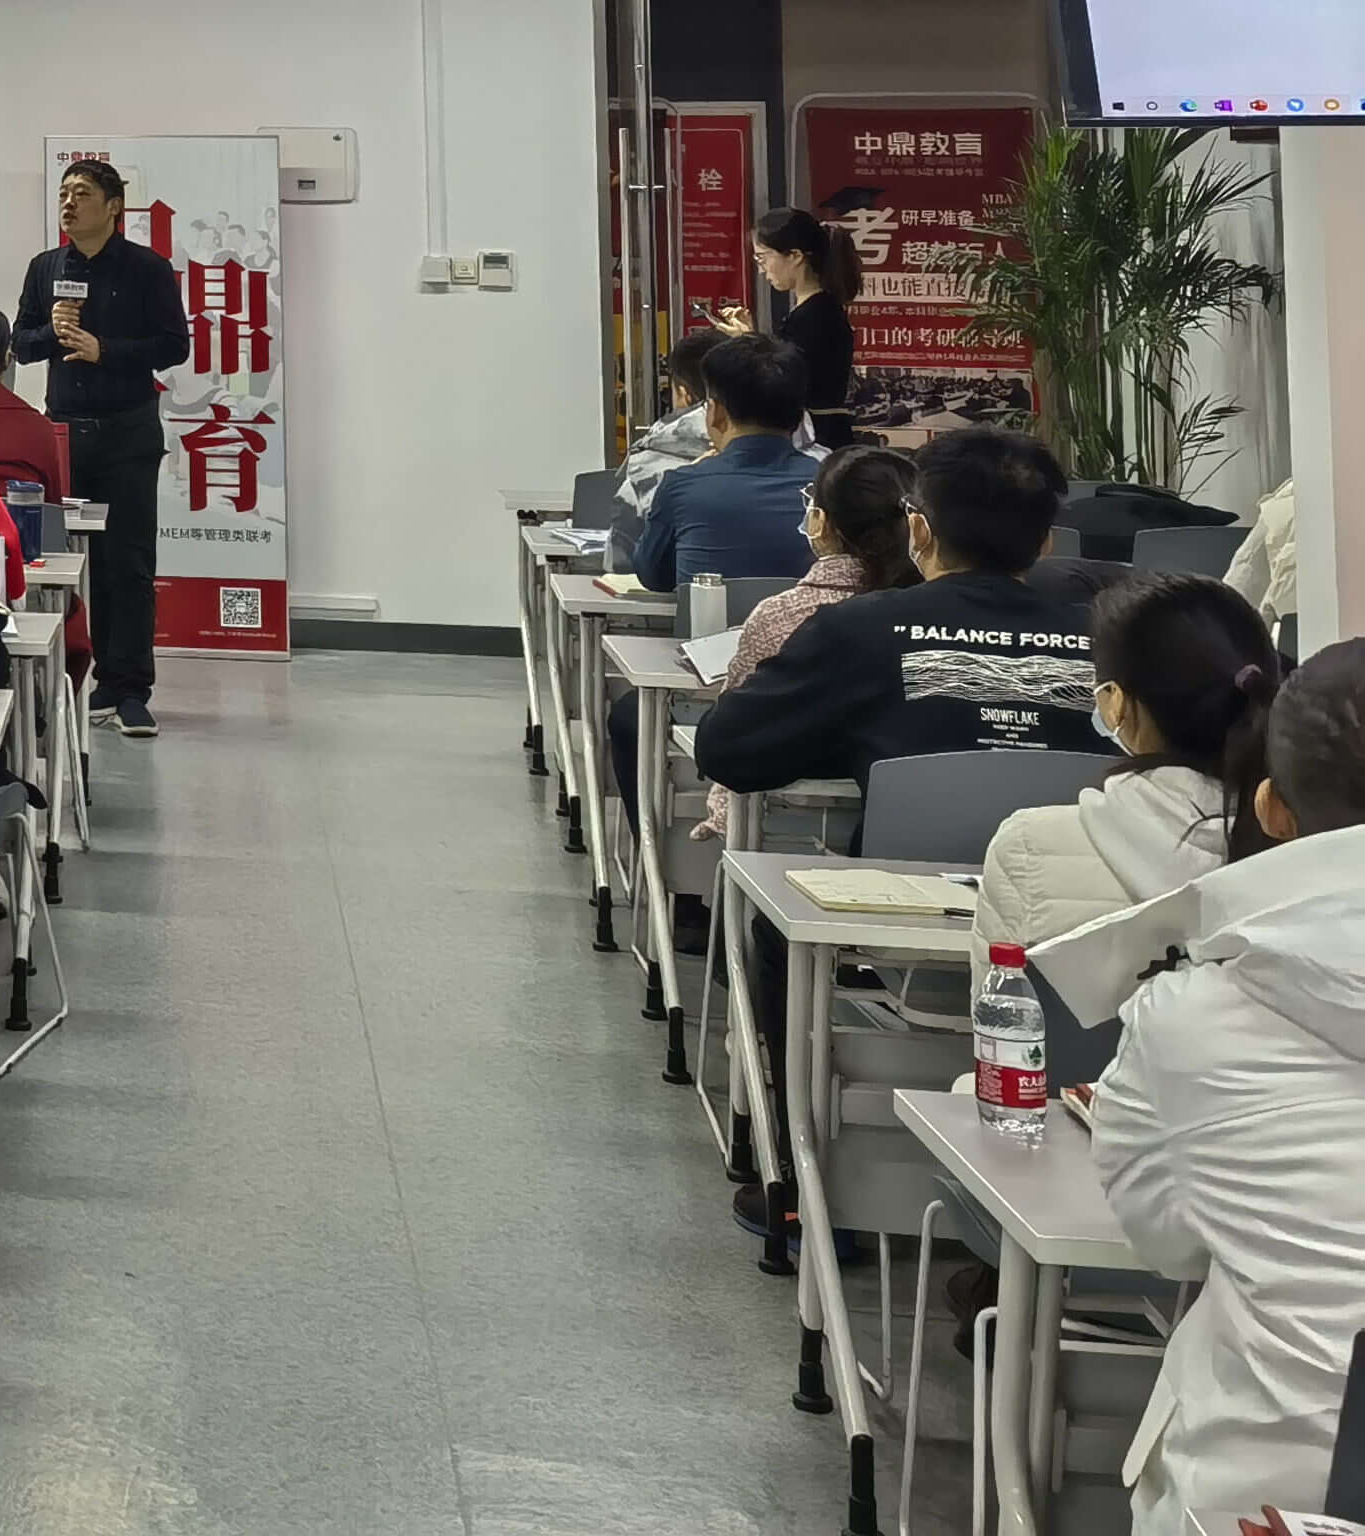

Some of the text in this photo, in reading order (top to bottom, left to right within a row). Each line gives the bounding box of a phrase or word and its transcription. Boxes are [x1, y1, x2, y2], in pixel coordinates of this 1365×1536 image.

[854, 131, 982, 156] 中鼎教育
[157, 527, 272, 544] MEM等管理类联考
[910, 625, 1091, 651] BALANCE FORCE
[980, 707, 1041, 726] SNOWFLAKE
